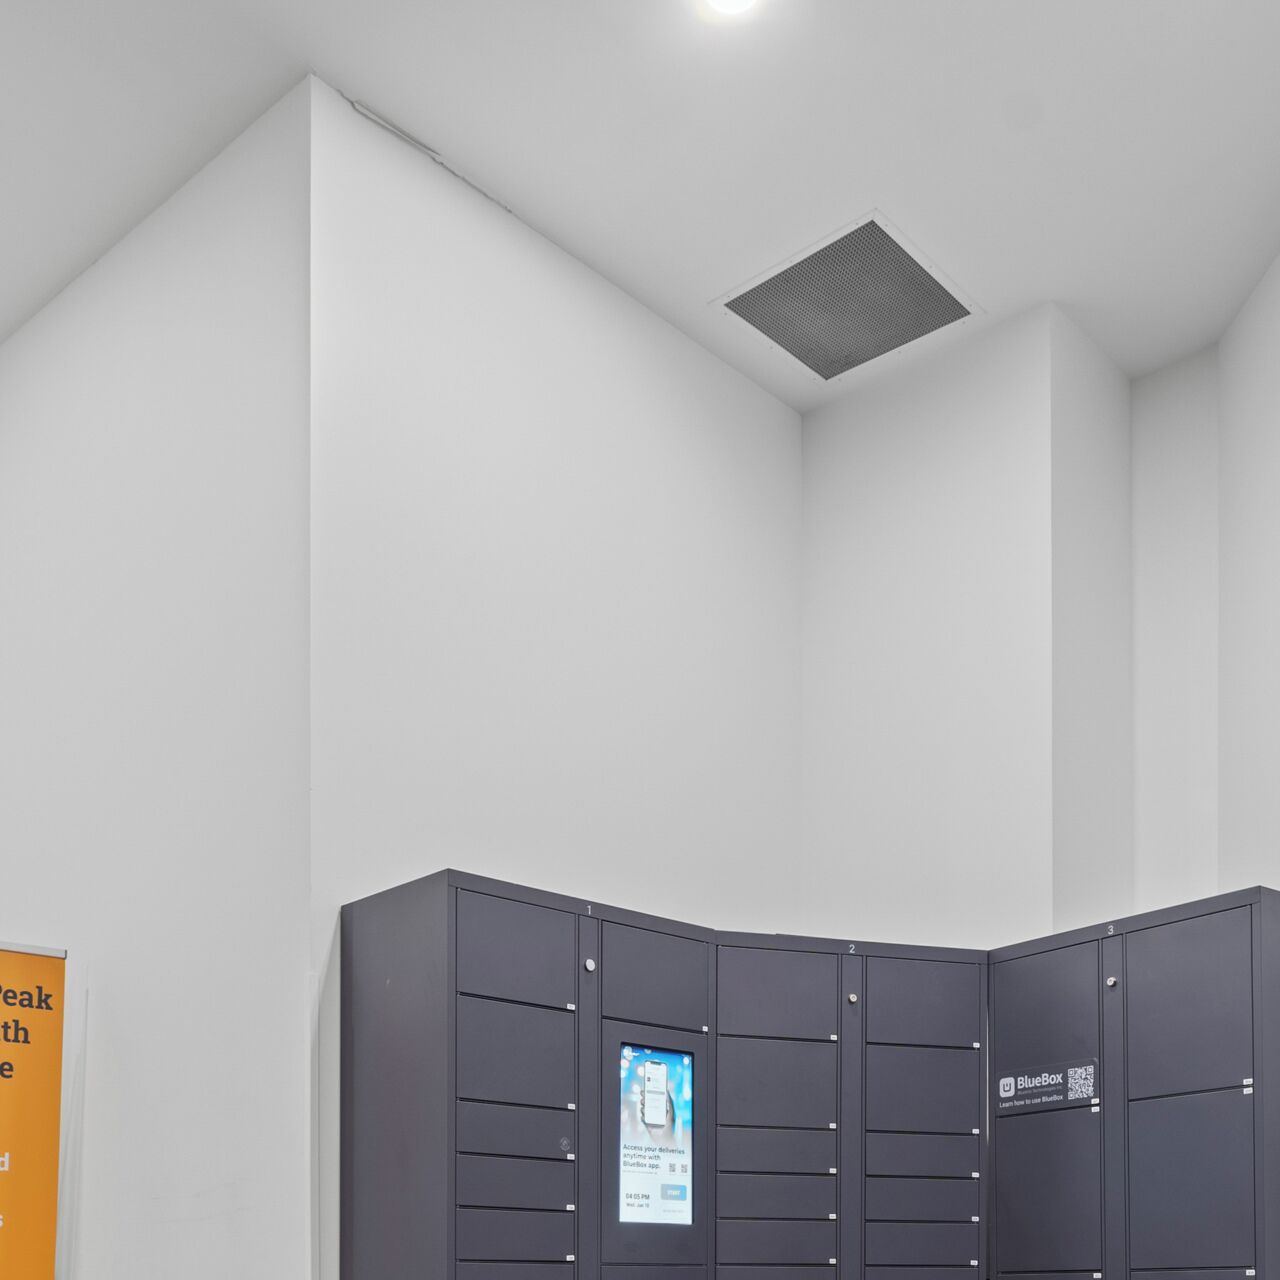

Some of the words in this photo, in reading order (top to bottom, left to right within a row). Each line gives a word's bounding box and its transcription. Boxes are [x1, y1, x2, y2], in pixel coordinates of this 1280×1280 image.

[586, 905, 592, 915] 1
[1107, 925, 1114, 935] 3
[849, 944, 856, 954] 2
[1017, 1073, 1063, 1089] BlueBox
[999, 1100, 1013, 1108] Learn
[1041, 1094, 1063, 1102] BlueBox
[658, 1147, 685, 1155] deliveries
